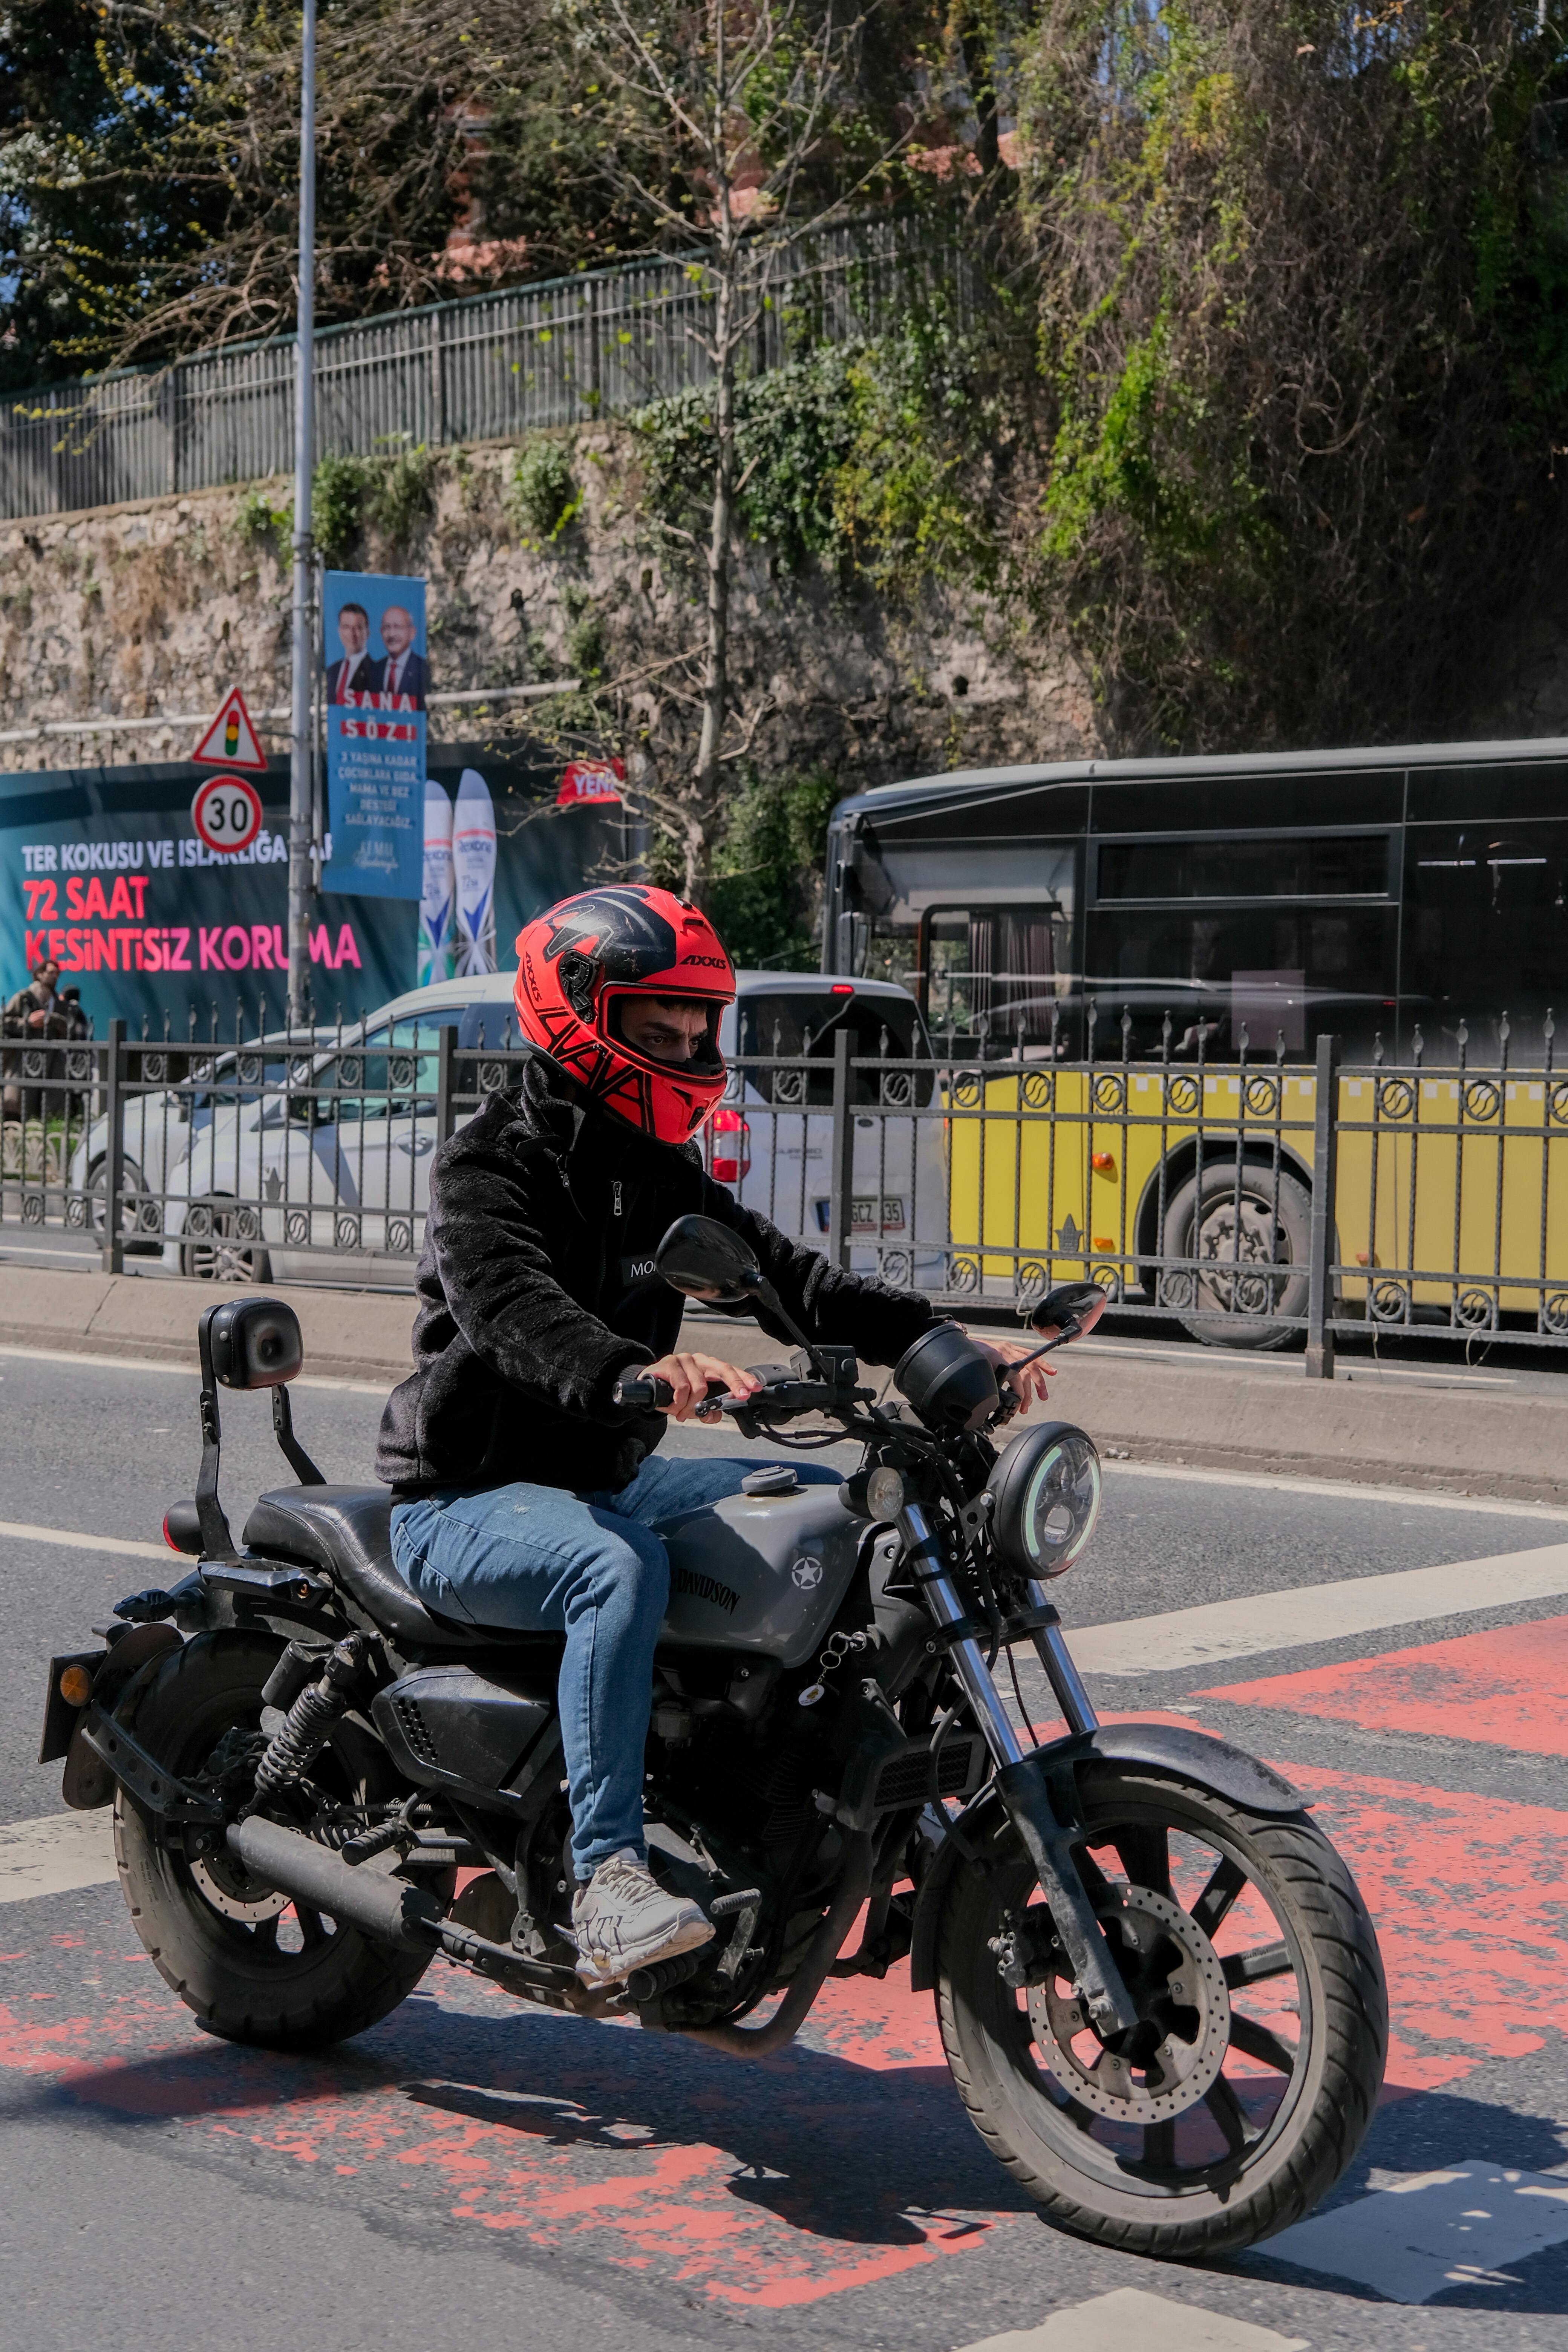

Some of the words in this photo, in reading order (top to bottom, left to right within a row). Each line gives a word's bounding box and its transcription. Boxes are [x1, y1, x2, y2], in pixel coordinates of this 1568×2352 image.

[343, 688, 412, 713] SANA
[345, 715, 412, 743] SÖZ!
[208, 798, 248, 832] 30
[21, 844, 58, 872] TER
[61, 841, 144, 871] KOKUSU
[146, 840, 175, 868] VE
[23, 879, 58, 921] 72
[66, 876, 149, 921] SAAT
[526, 951, 543, 1003] AXXIS
[679, 954, 727, 970] AXXIS
[631, 1260, 656, 1277] MO
